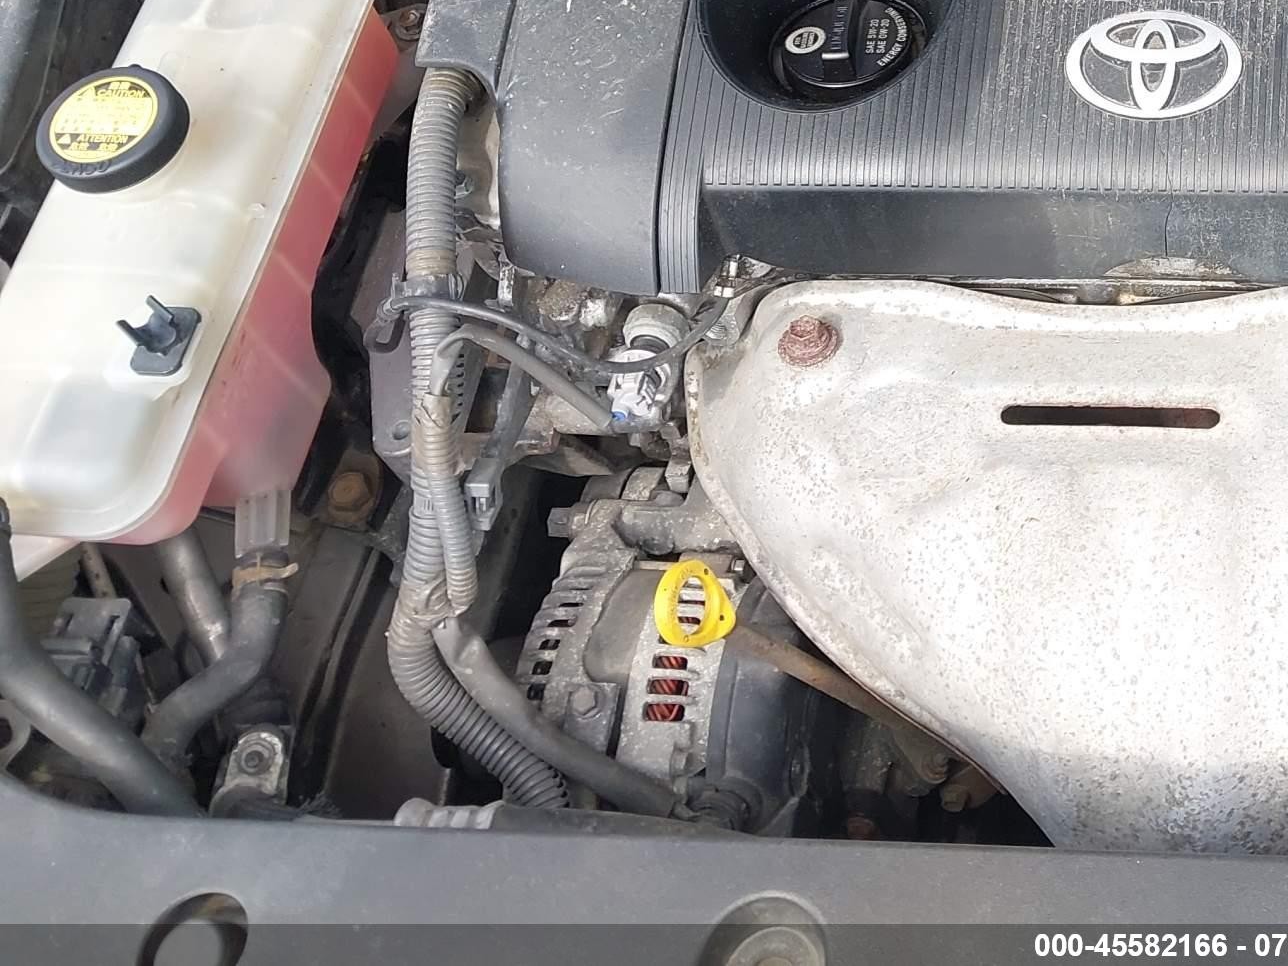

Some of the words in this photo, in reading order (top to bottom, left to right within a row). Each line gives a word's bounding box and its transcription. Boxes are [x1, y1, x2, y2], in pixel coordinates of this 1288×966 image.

[868, 18, 880, 38] 5W-20
[885, 7, 908, 42] CONSERVING
[866, 40, 876, 54] SAE
[876, 40, 887, 54] SAE
[876, 42, 904, 67] ENERGY
[96, 89, 145, 99] CAUTION
[77, 135, 129, 144] ATTENTION
